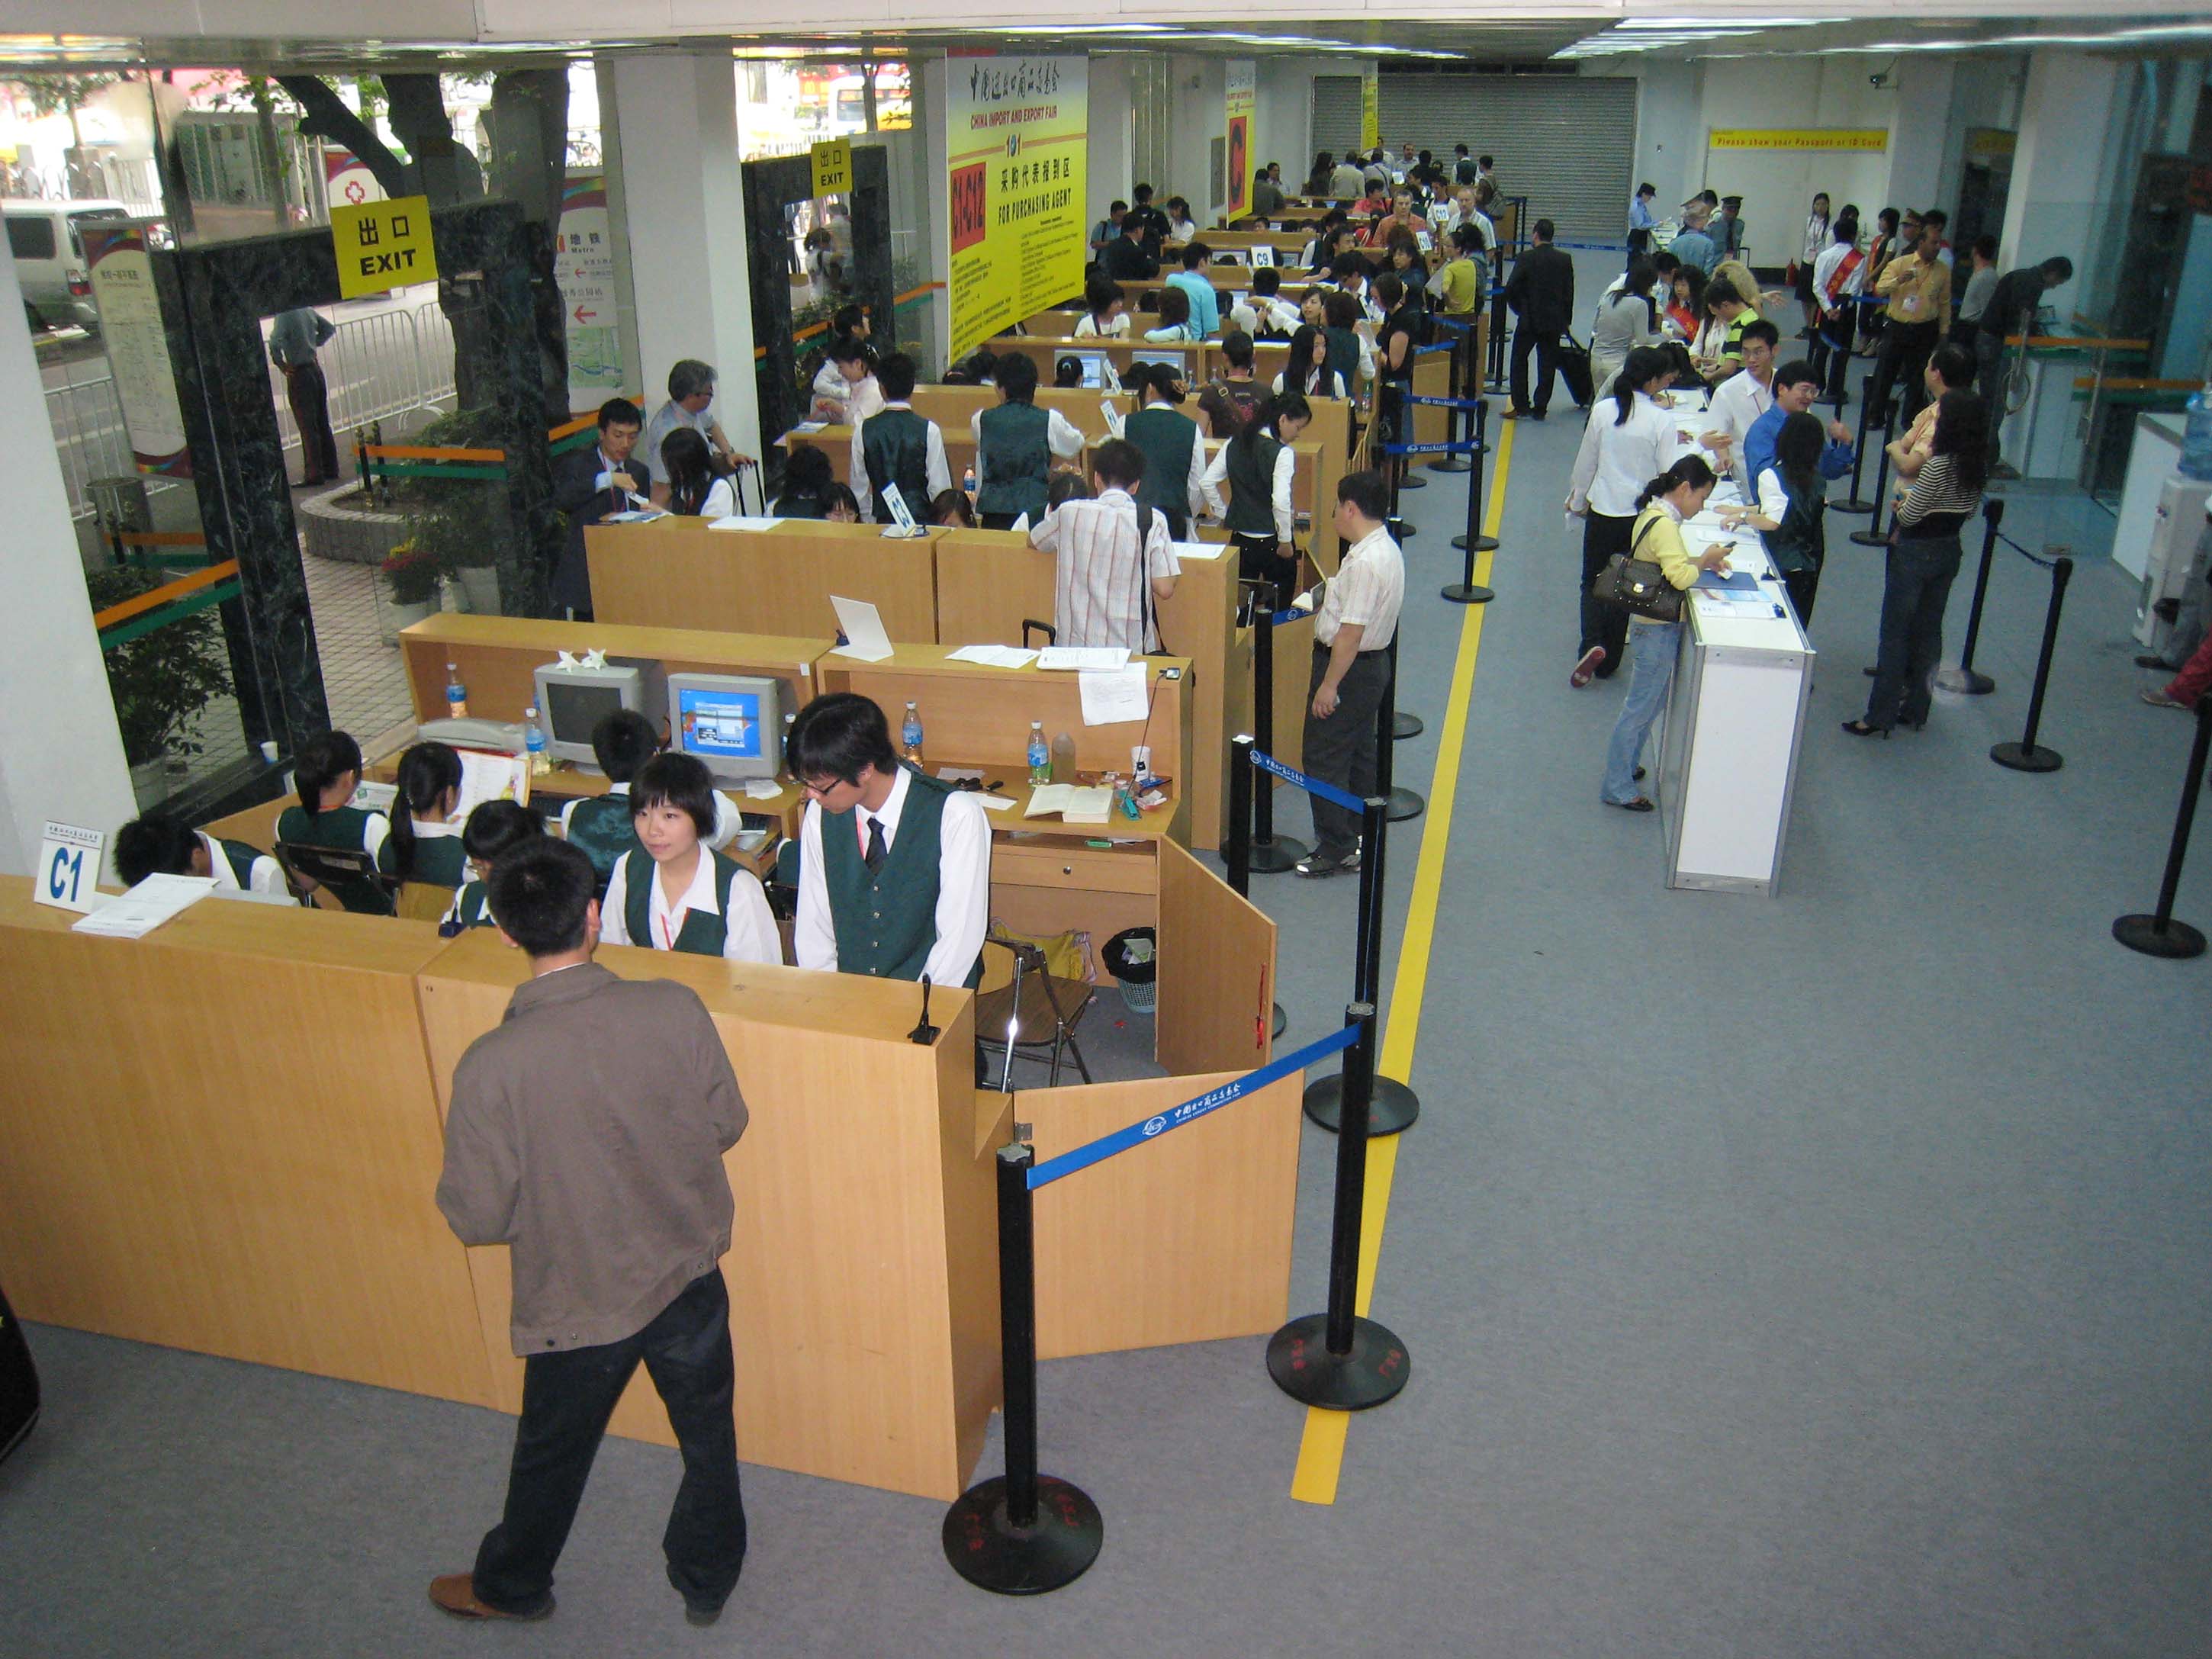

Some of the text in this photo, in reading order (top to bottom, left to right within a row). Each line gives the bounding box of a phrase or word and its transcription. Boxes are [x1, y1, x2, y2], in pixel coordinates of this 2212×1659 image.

[970, 104, 1058, 130] CHINA IMPORT AND EXPORT FAIR
[820, 150, 842, 167] 出口
[821, 172, 844, 187] EXIT
[1001, 157, 1070, 194] 采购代表报到区
[998, 203, 1010, 227] FOR
[1011, 193, 1050, 222] PURCHASING
[1052, 188, 1072, 209] AGENT
[358, 216, 410, 246] 出口
[360, 249, 416, 276] EXIT
[1256, 252, 1269, 266] C9
[50, 847, 84, 902] C1
